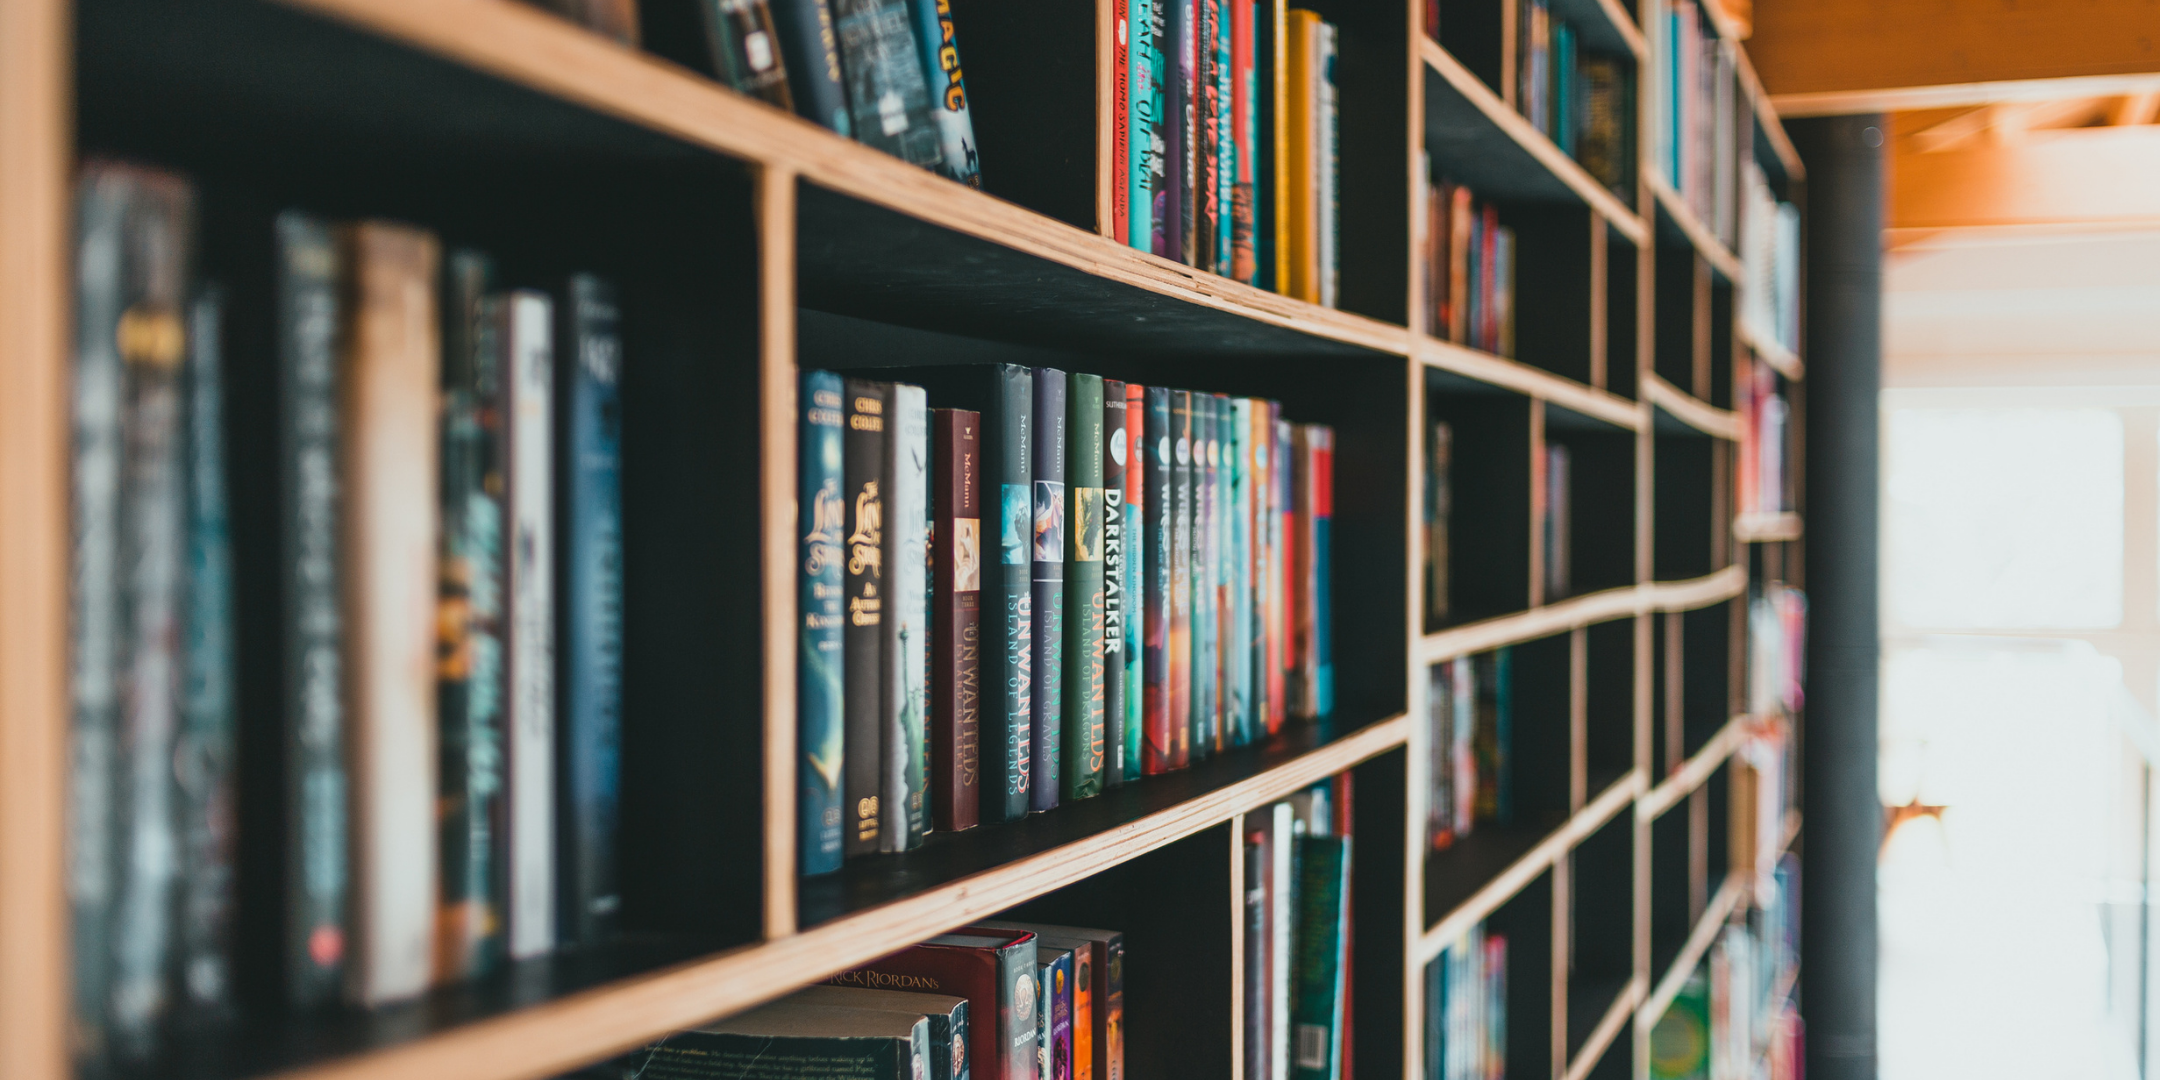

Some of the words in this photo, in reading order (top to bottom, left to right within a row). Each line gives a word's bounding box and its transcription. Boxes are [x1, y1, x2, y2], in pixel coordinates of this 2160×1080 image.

[1104, 489, 1121, 654] DARKSTALKER
[1008, 594, 1018, 664] ISLAND
[1044, 610, 1053, 667] ISLAND
[1082, 603, 1091, 658] ISLAND
[963, 624, 979, 787] UNWANTEDS
[1008, 677, 1018, 699] OF
[1017, 594, 1031, 793] UNWANTEDS
[1044, 674, 1052, 693] OF
[1082, 665, 1091, 684] OF
[1090, 591, 1104, 772] UNWANTEDS
[1008, 712, 1018, 795] LEGENDS
[1043, 701, 1052, 762] GRAVES
[1082, 691, 1091, 760] DRAGONS
[866, 970, 939, 989] RIORDAN's
